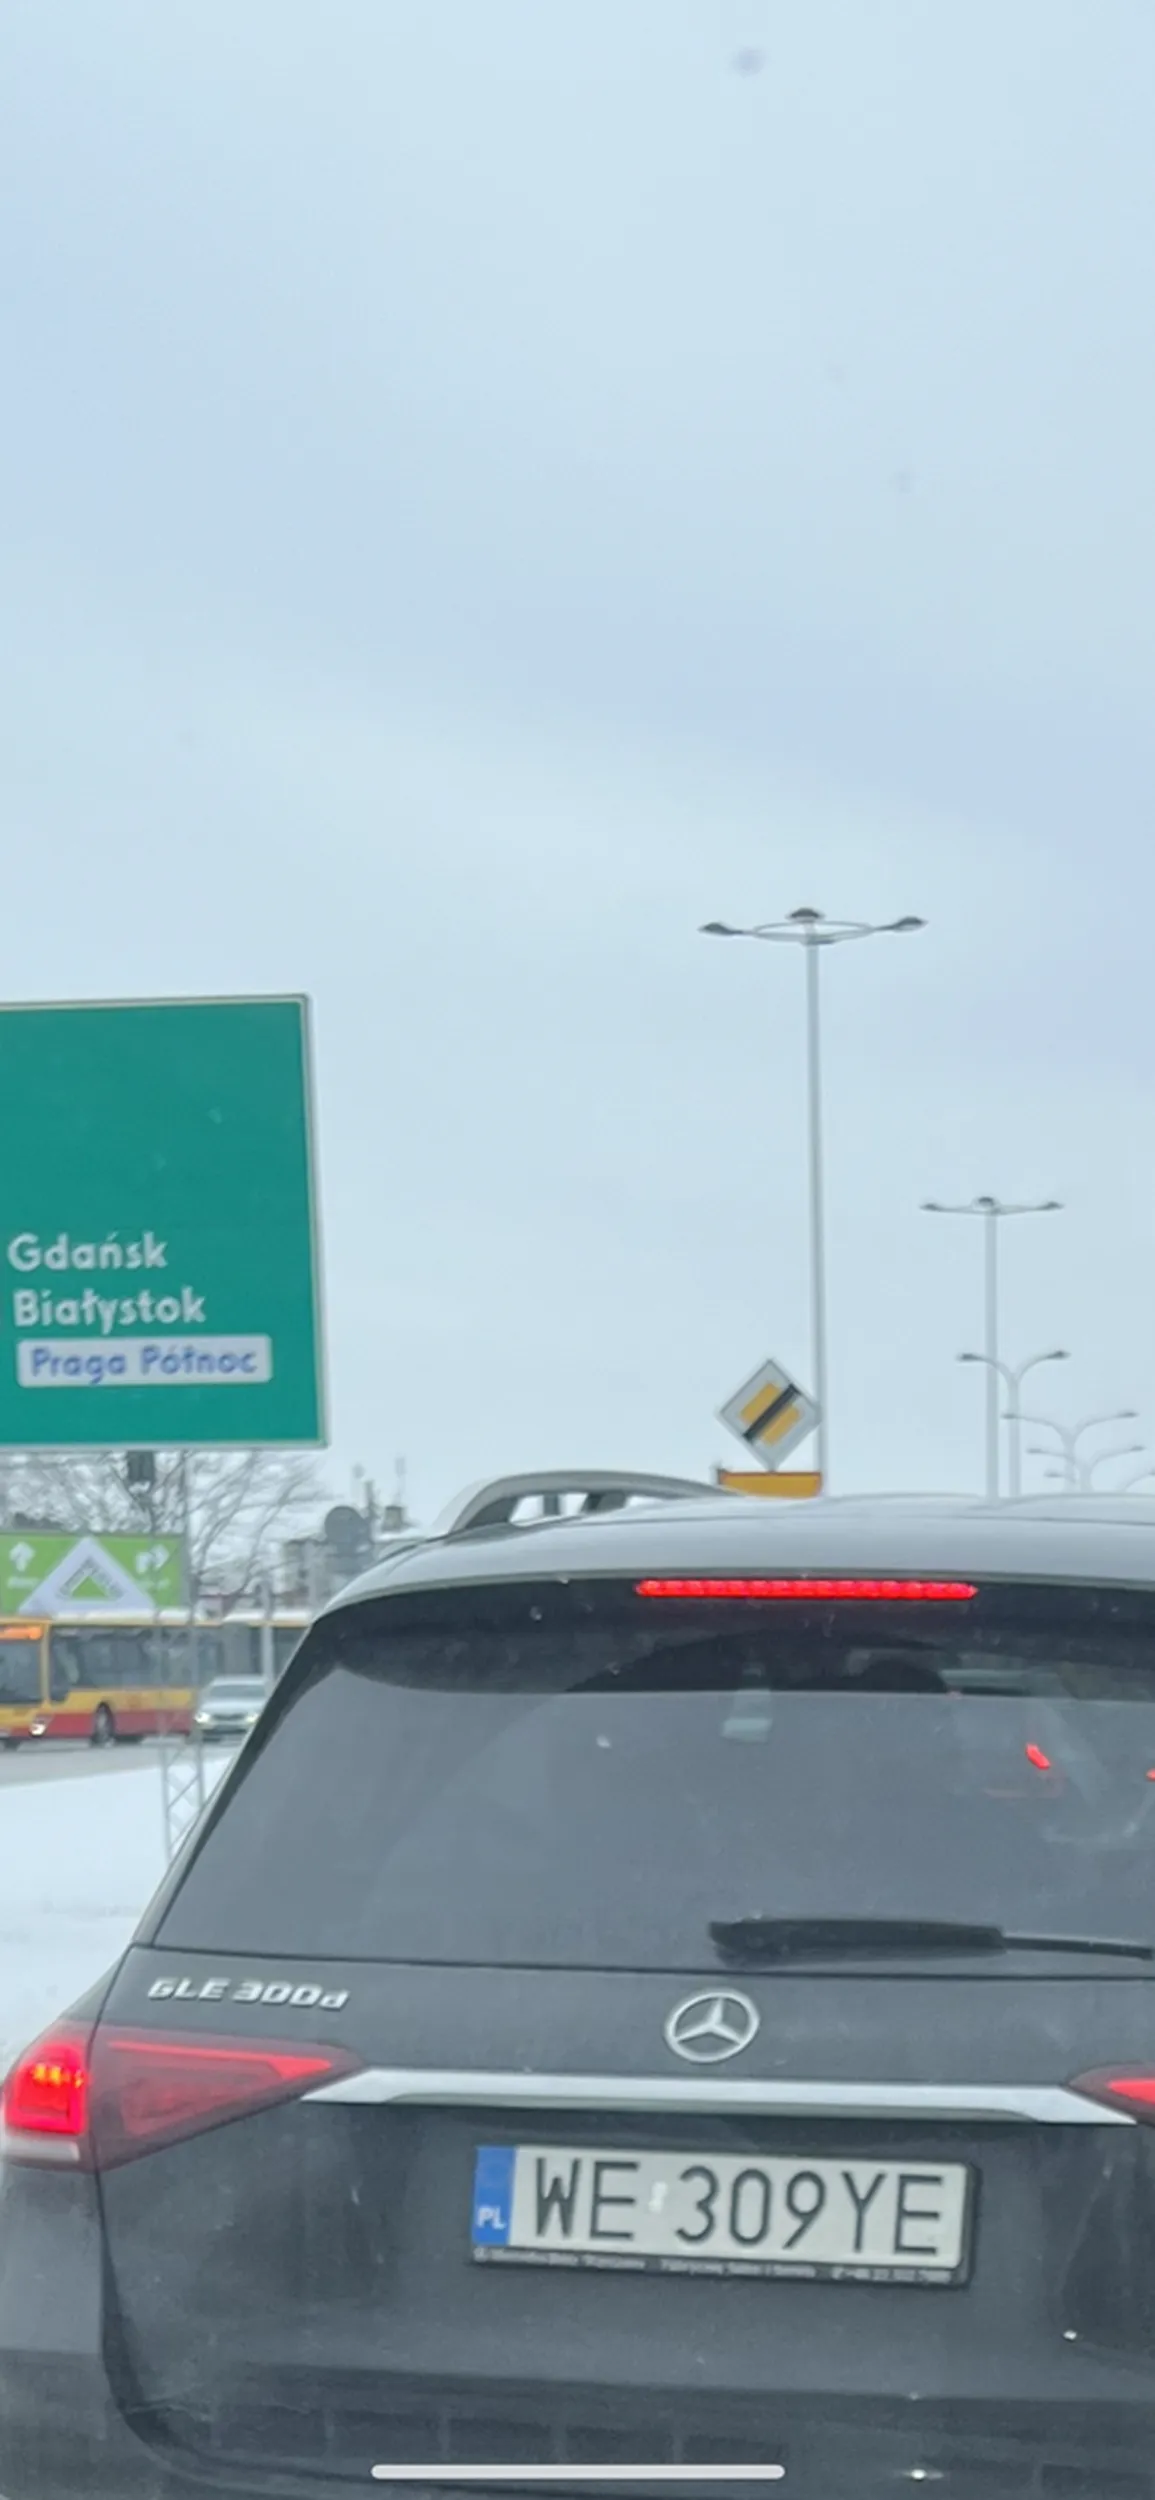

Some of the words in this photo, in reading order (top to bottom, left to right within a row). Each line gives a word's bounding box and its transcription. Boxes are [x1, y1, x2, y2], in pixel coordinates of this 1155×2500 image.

[8, 1231, 168, 1272] Gdańsk
[13, 1285, 206, 1335] Białystok
[31, 1347, 127, 1384] Praga
[140, 1345, 257, 1375] Północ
[147, 1977, 231, 1999] GLE
[232, 1978, 349, 2011] 300d
[477, 2206, 506, 2230] PL
[534, 2157, 640, 2241] WE
[675, 2165, 944, 2255] 309YE
